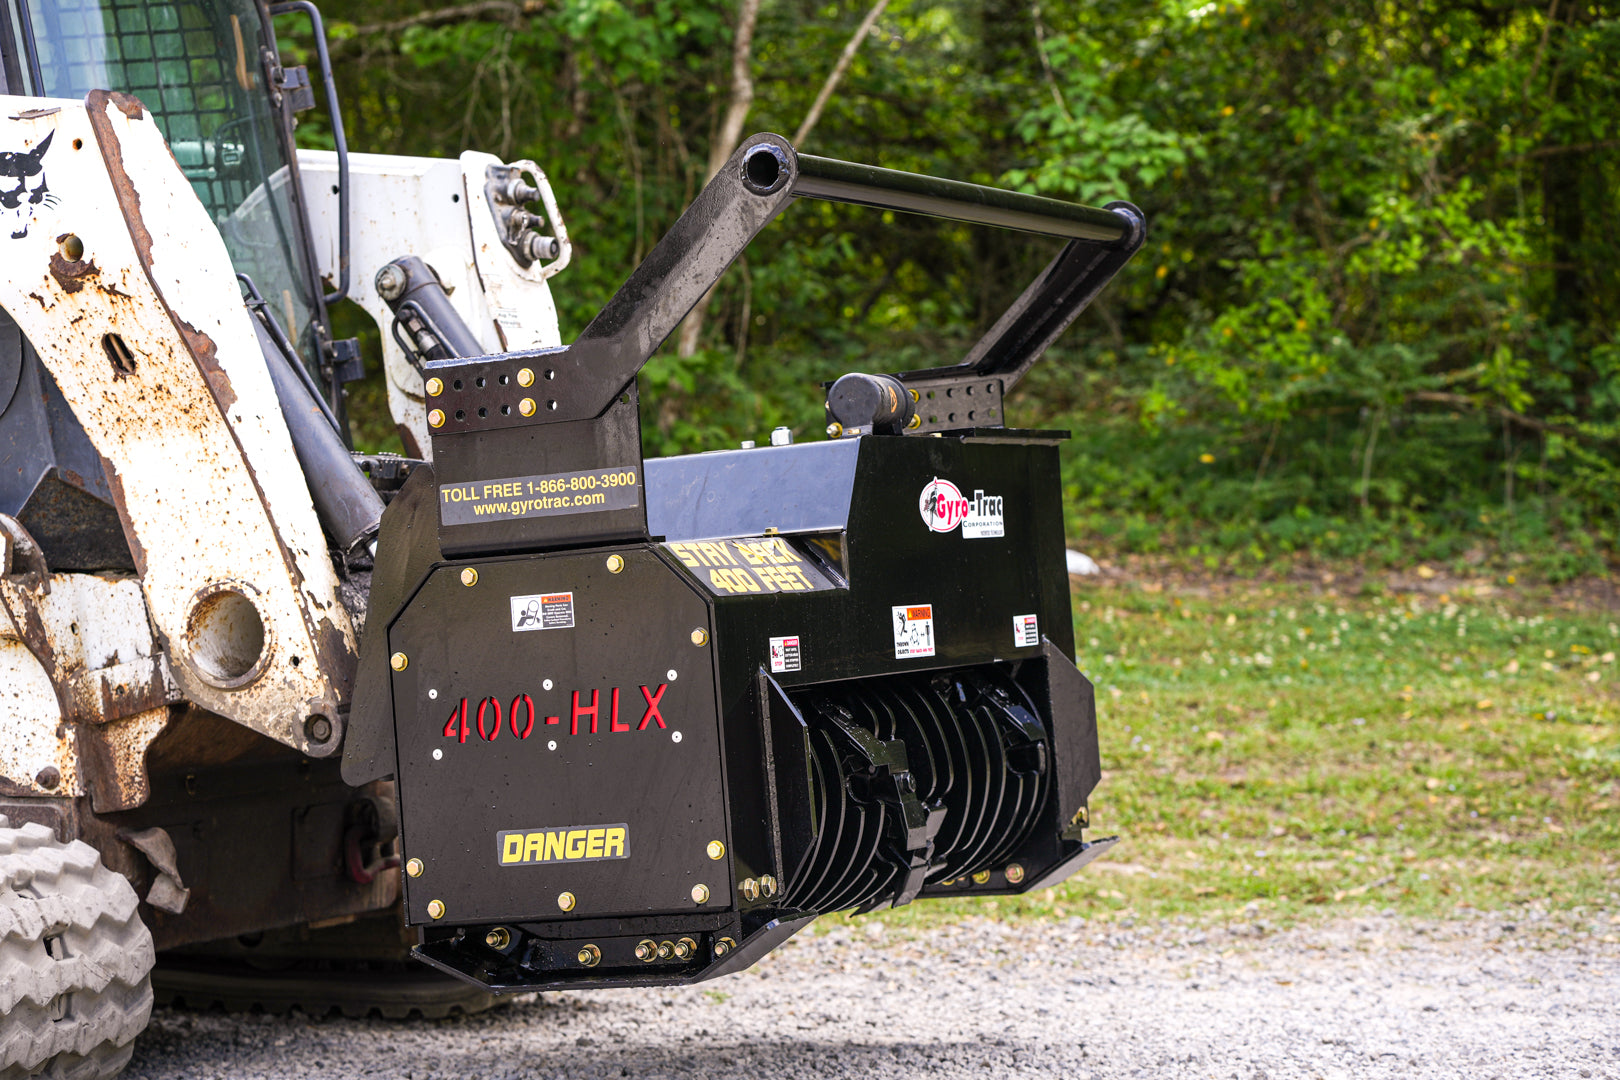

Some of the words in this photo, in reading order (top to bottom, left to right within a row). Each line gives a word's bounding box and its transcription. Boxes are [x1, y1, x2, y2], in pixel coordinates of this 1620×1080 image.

[441, 487, 480, 503] TOLL
[483, 482, 523, 499] FREE
[526, 471, 636, 495] 1-866-800-3900
[473, 493, 605, 516] www.gyrotrac.com
[937, 492, 1002, 525] Gyro-Trac
[669, 541, 739, 567] STAY
[733, 538, 803, 565] BACK
[709, 567, 762, 593] 400
[751, 565, 815, 591] FEET
[912, 608, 931, 618] WARNING
[442, 683, 669, 744] 400-HLX
[501, 827, 626, 864] DANGER
